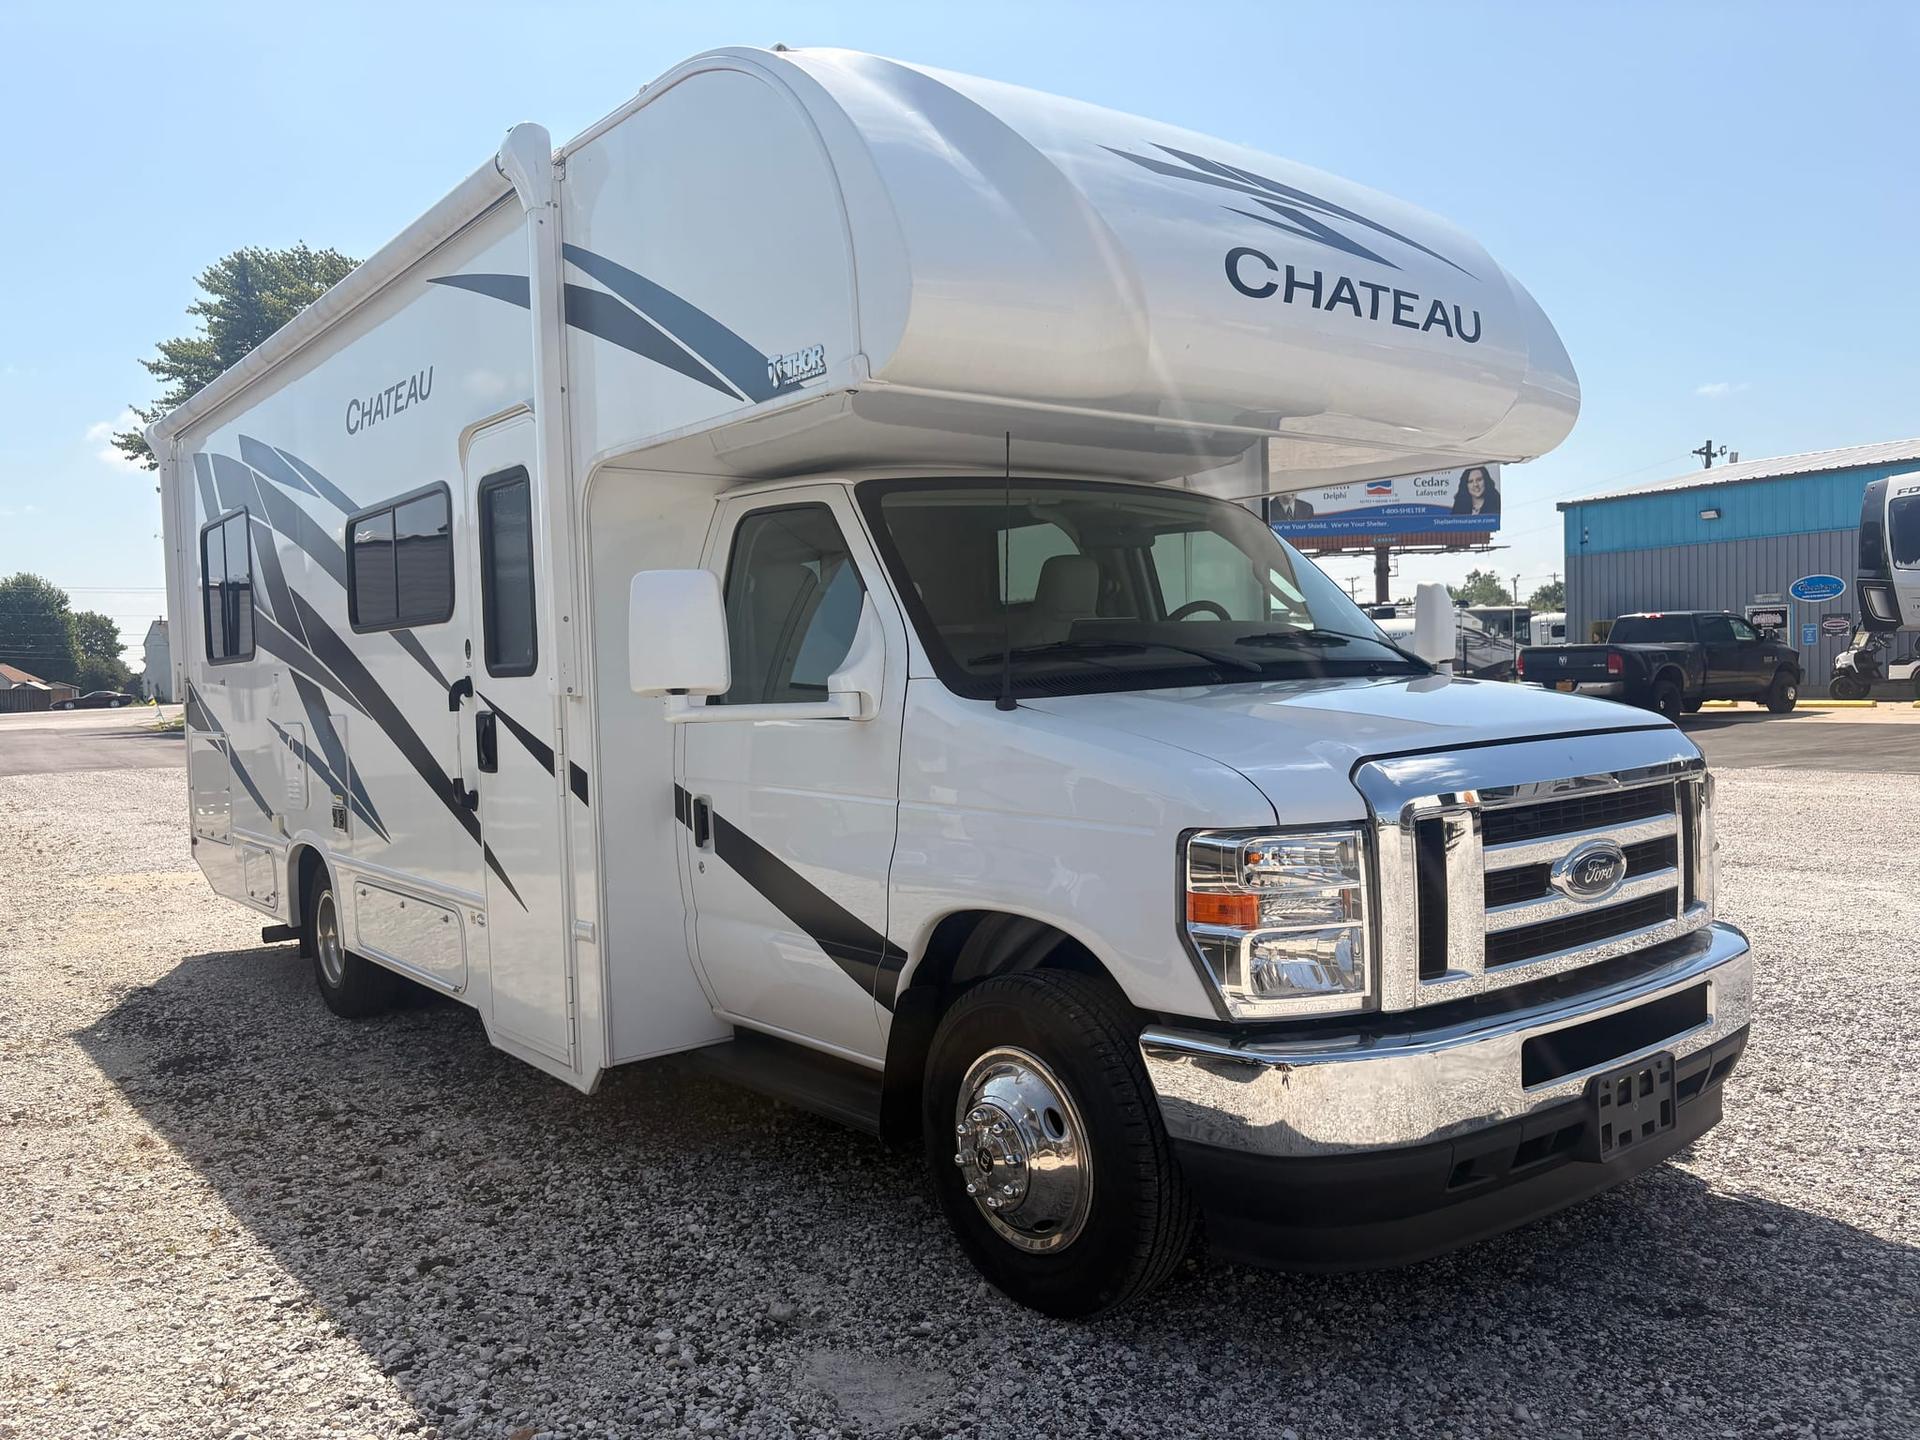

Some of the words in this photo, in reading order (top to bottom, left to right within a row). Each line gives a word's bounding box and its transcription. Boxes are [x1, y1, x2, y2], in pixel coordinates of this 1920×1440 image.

[1224, 247, 1481, 343] CHATEAU
[782, 344, 826, 378] THOR
[346, 365, 433, 435] CHATEAU
[1413, 477, 1450, 487] Cedars
[1415, 489, 1448, 497] Lafayette
[1323, 491, 1347, 501] Delphi
[1584, 858, 1615, 884] Ford
